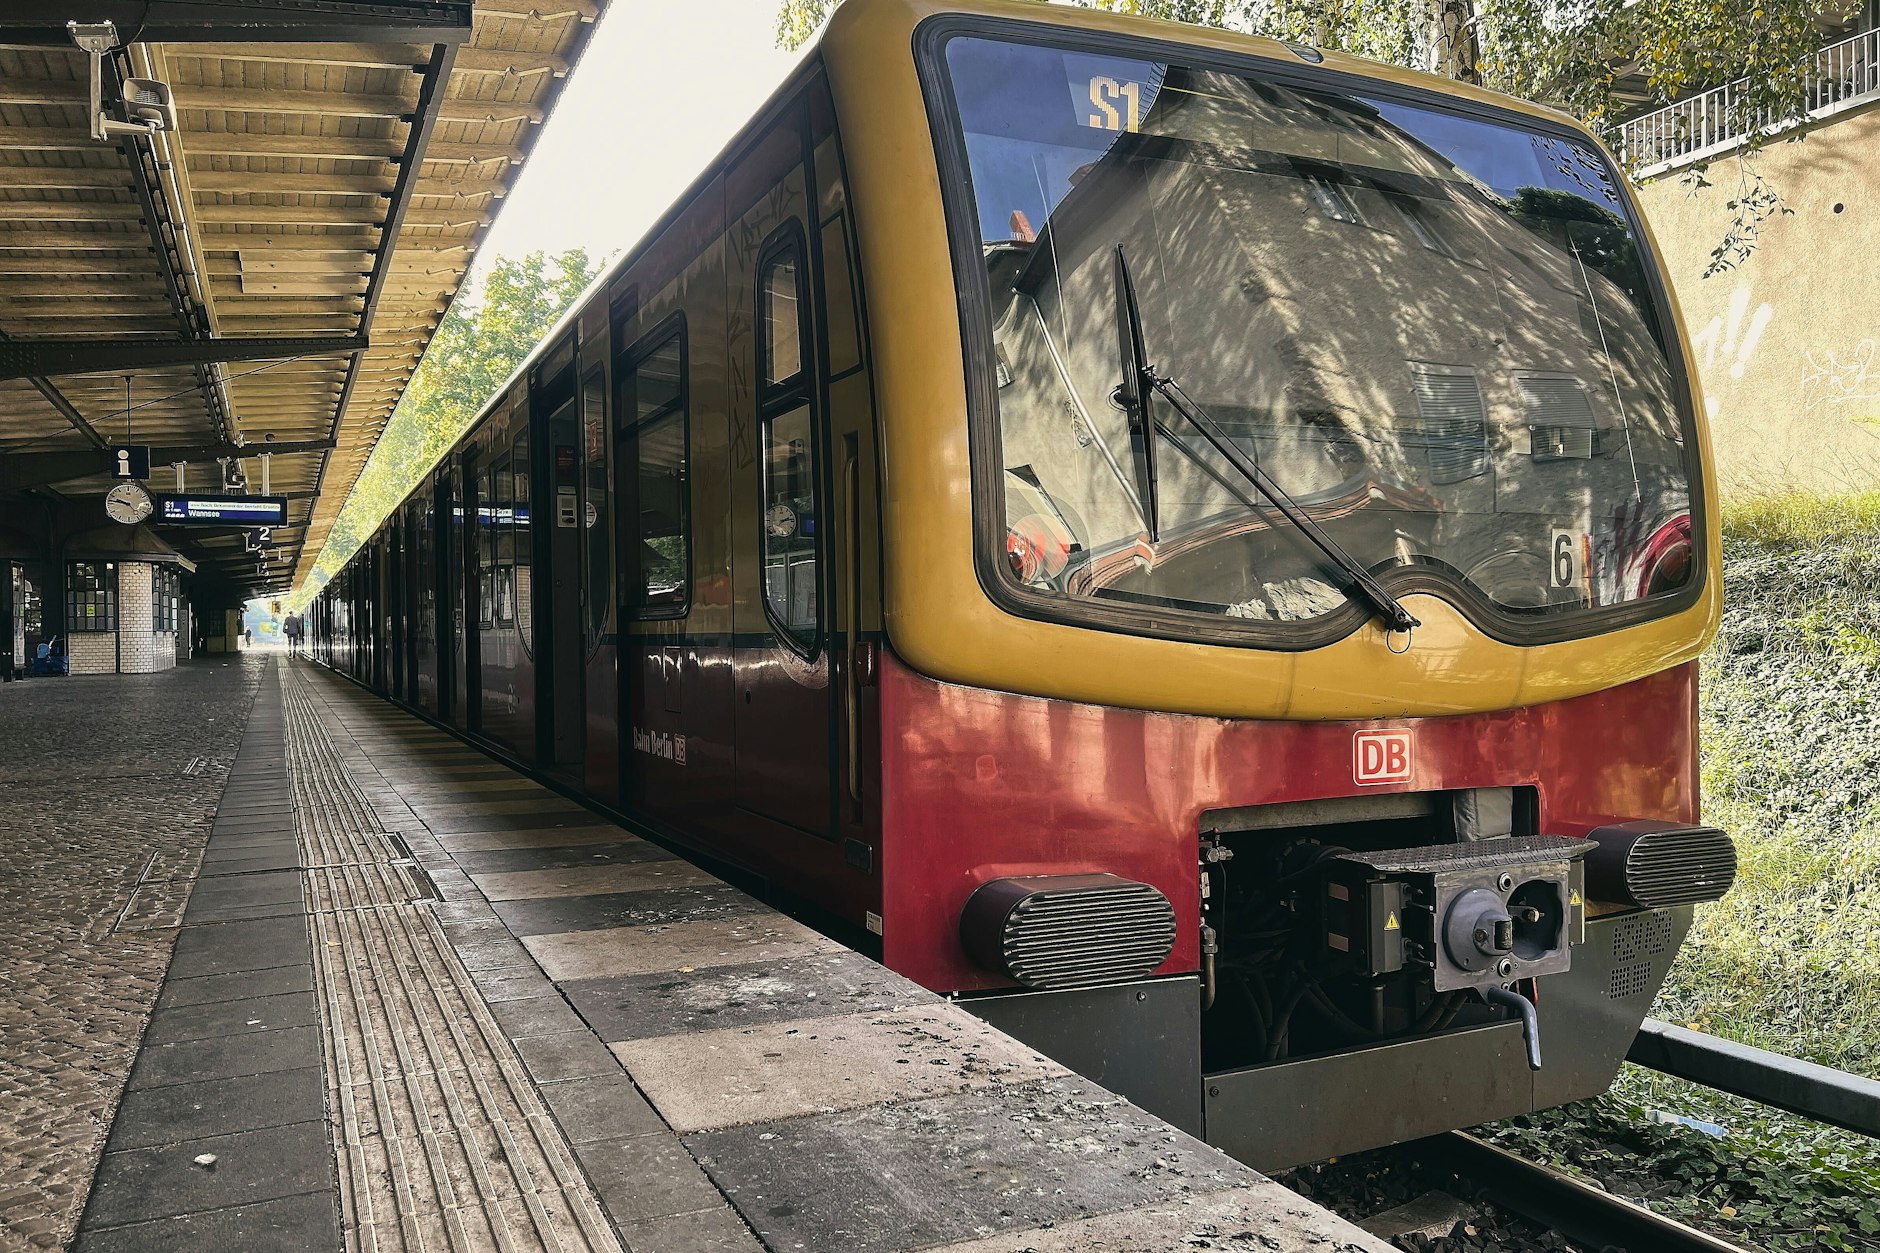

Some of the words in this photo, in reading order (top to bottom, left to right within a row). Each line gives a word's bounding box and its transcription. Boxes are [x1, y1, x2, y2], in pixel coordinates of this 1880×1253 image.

[1089, 75, 1139, 134] S1
[259, 526, 270, 541] 2
[1554, 533, 1573, 588] 6
[651, 729, 673, 760] Berlin
[1359, 735, 1409, 778] DB
